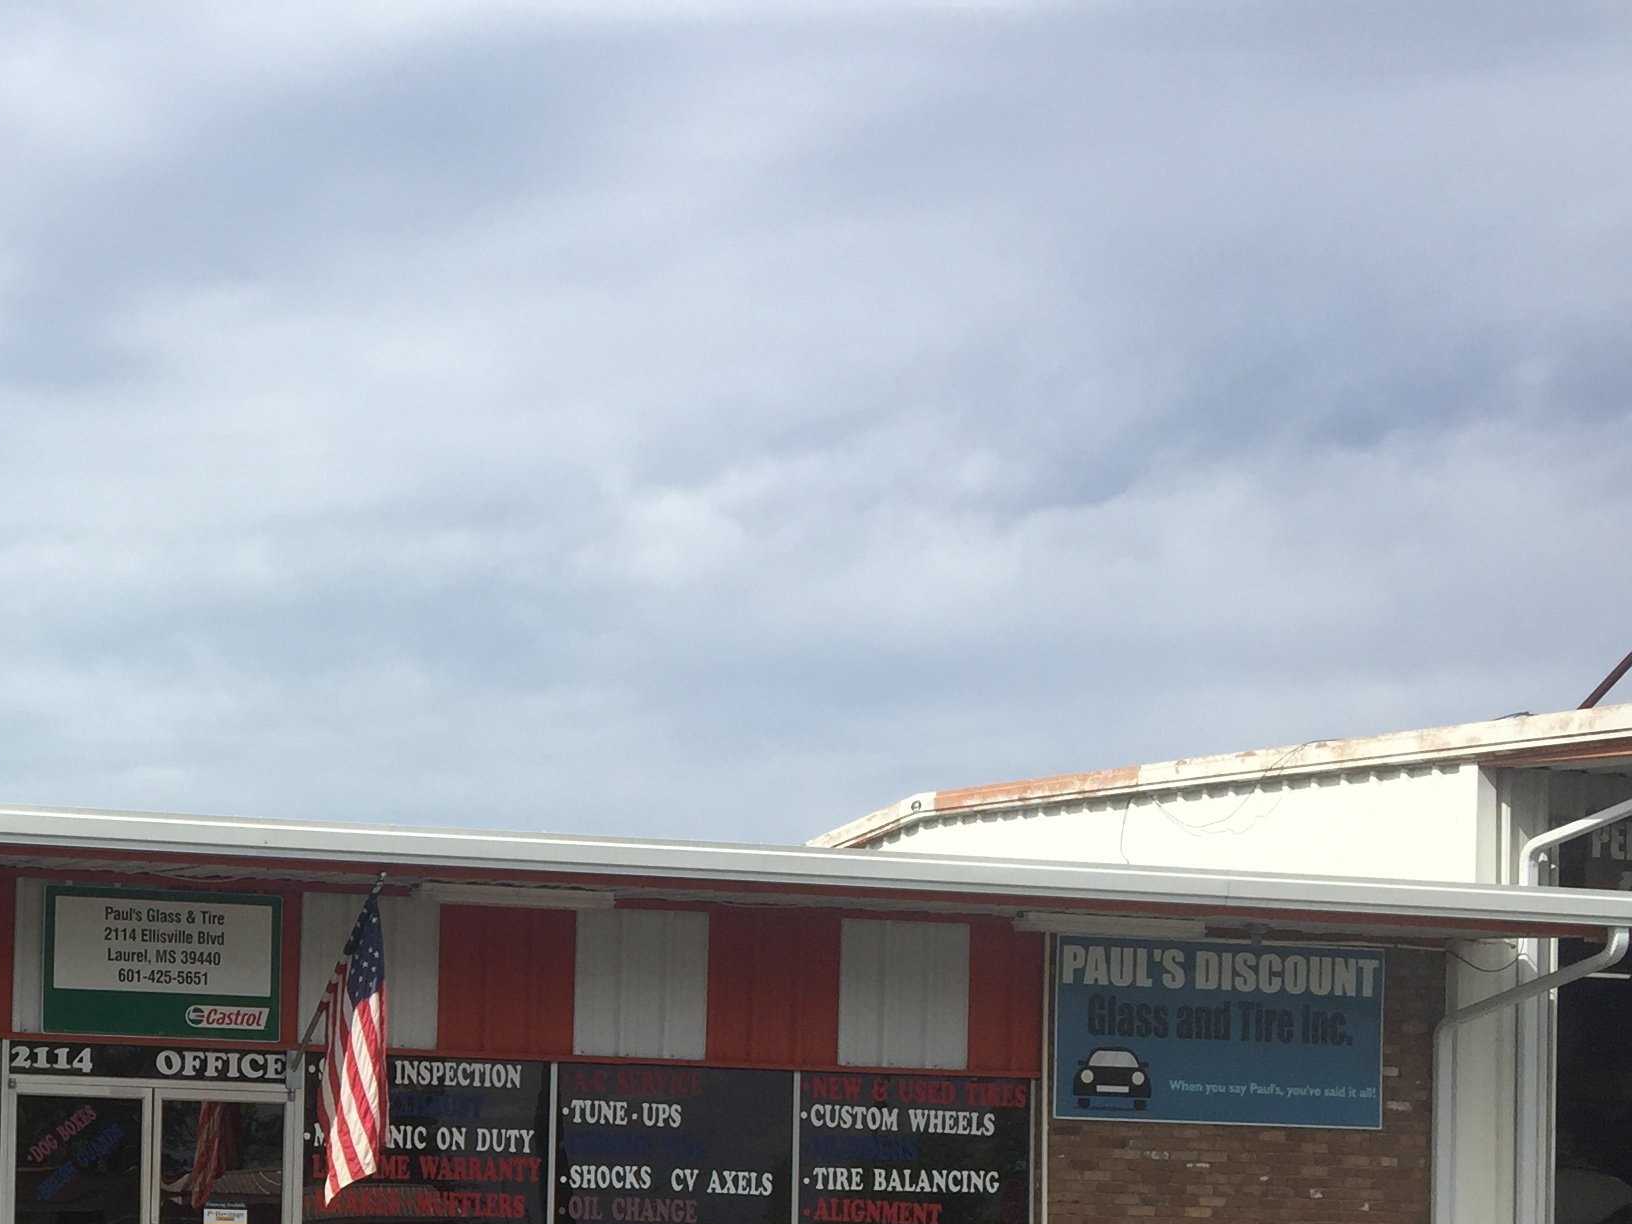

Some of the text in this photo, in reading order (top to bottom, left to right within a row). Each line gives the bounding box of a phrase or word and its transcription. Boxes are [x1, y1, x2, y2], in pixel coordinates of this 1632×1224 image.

[105, 907, 225, 925] Paul's Glass & Tire
[104, 927, 225, 946] 2114 Ellisville Blvd
[107, 948, 221, 966] Laurel, MS 39440
[1062, 944, 1379, 998] PAUL'S DISCOUNT
[118, 968, 209, 986] 601-425-5651
[205, 1008, 263, 1027] Castrol
[1087, 994, 1354, 1047] Glass and Tire Inc.
[11, 1046, 93, 1073] 2114
[155, 1050, 286, 1080] OFFICE
[395, 1060, 521, 1088] INSPECTION
[812, 1077, 862, 1101] NEW
[1170, 1079, 1202, 1092] When
[1205, 1083, 1226, 1096] you
[1229, 1084, 1247, 1096] say
[1287, 1085, 1321, 1098] you've
[1325, 1085, 1346, 1098] said
[29, 1104, 97, 1163] DOG BOXES
[810, 1104, 996, 1137] CUSTOM WHEELS
[314, 1123, 535, 1153] MNIC ON DUTY
[419, 1155, 542, 1183] WARRANTY
[569, 1165, 773, 1196] SHOCKS CV AXELS
[813, 1167, 1000, 1194] TIRE BALANCING
[416, 1190, 525, 1218] MUFFLERS
[569, 1196, 697, 1224] OIL CHANGE
